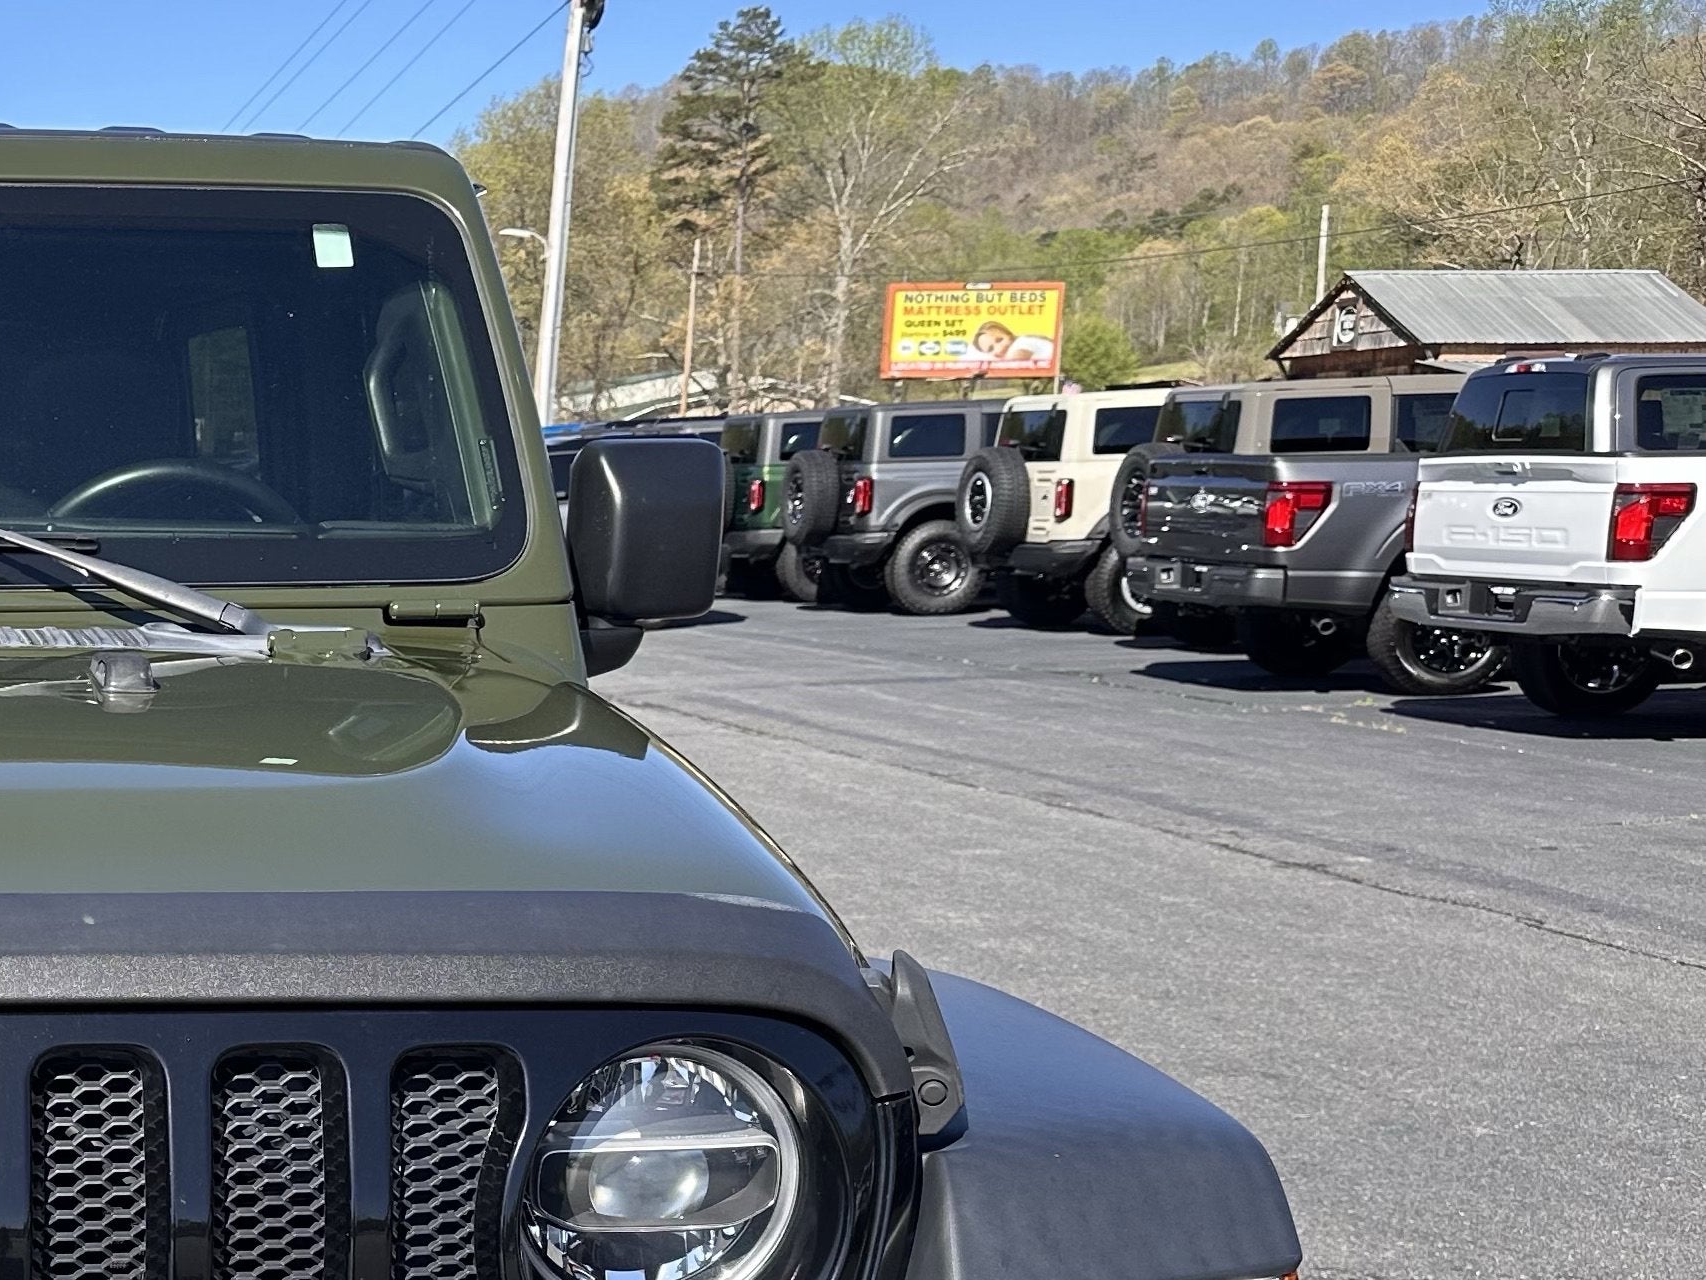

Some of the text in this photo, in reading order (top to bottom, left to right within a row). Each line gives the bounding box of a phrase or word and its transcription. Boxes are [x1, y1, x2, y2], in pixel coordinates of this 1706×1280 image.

[903, 292, 1047, 304] NOTHING BUT BEDS
[903, 304, 1045, 316] MATTRESS OUTLET
[904, 319, 964, 328] QUEEN SET
[1443, 524, 1569, 548] F-150
